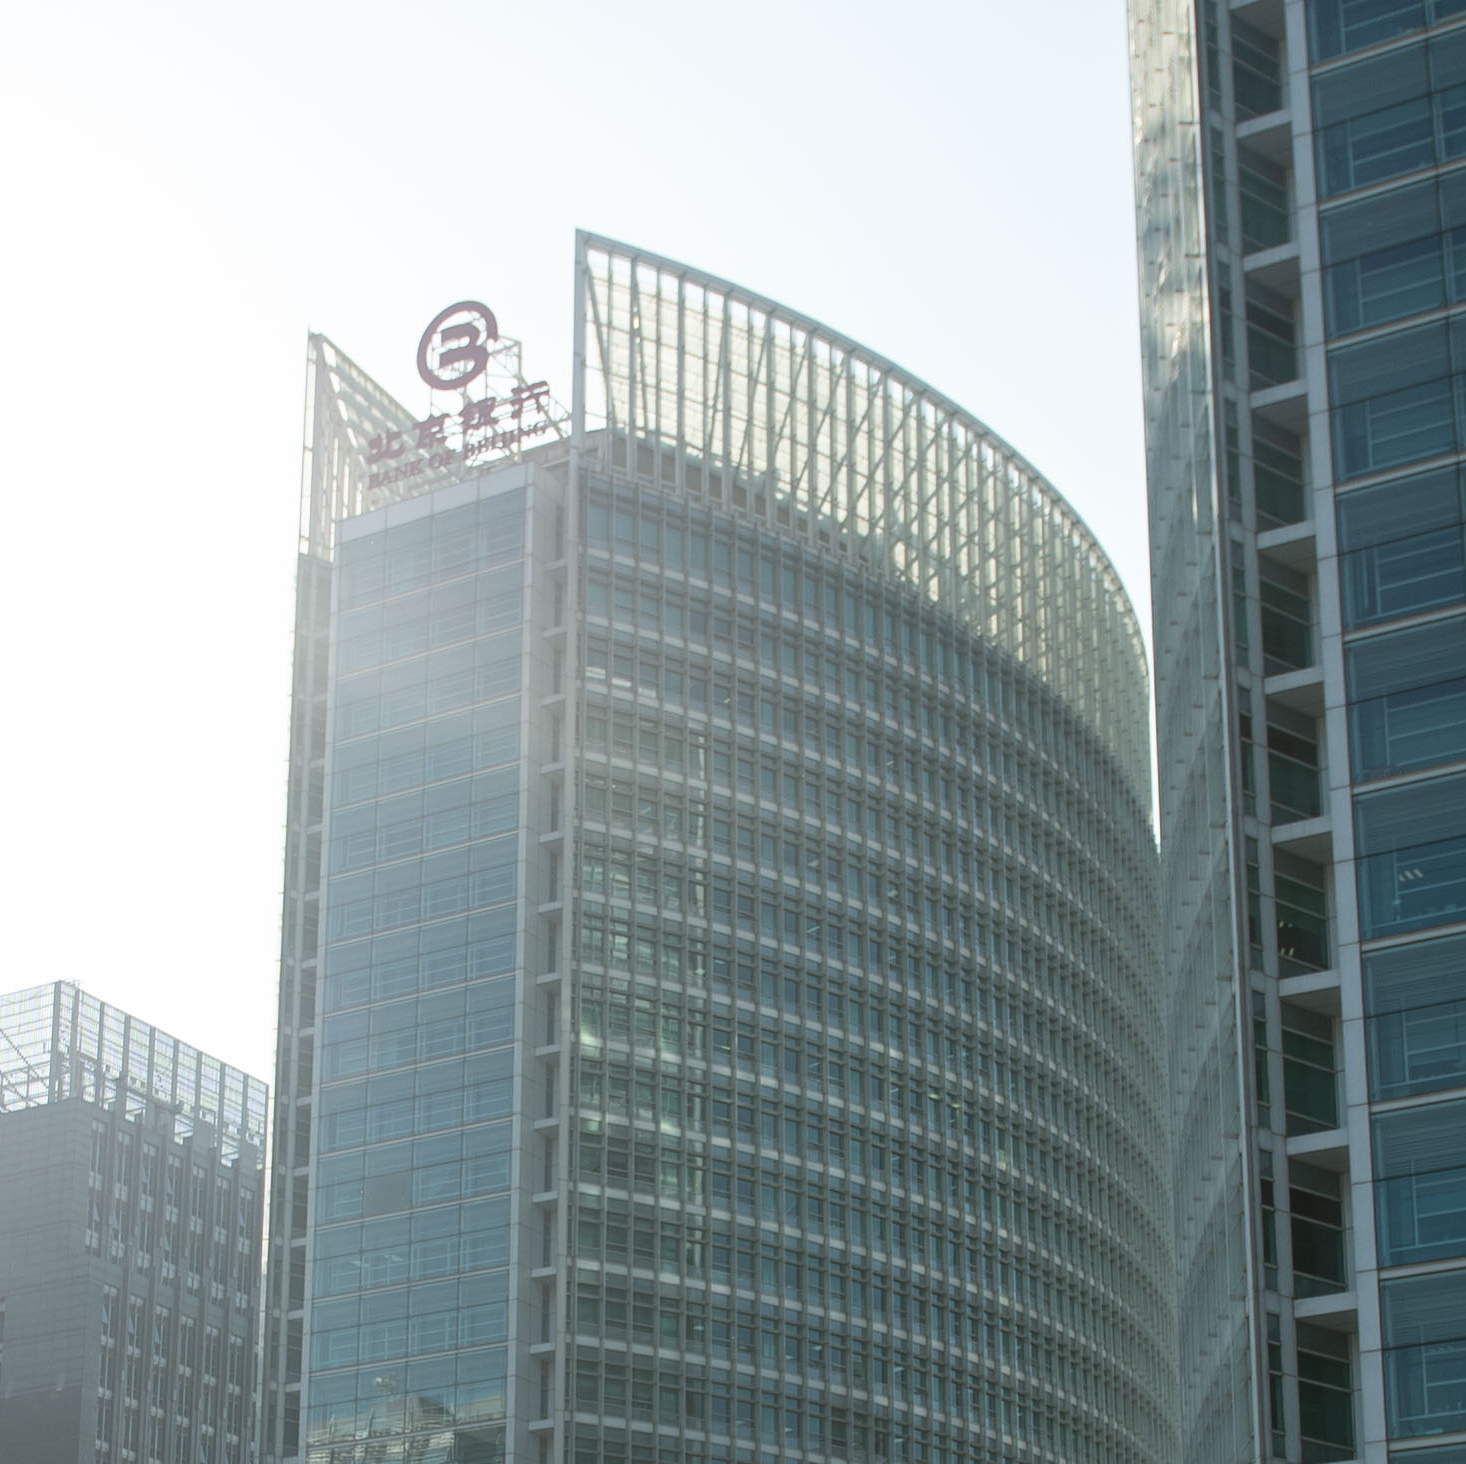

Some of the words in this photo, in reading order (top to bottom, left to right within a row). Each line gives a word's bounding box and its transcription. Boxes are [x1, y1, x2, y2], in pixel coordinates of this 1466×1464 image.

[366, 380, 550, 465] 北京银行
[367, 457, 424, 490] BANK
[429, 448, 457, 470] OF
